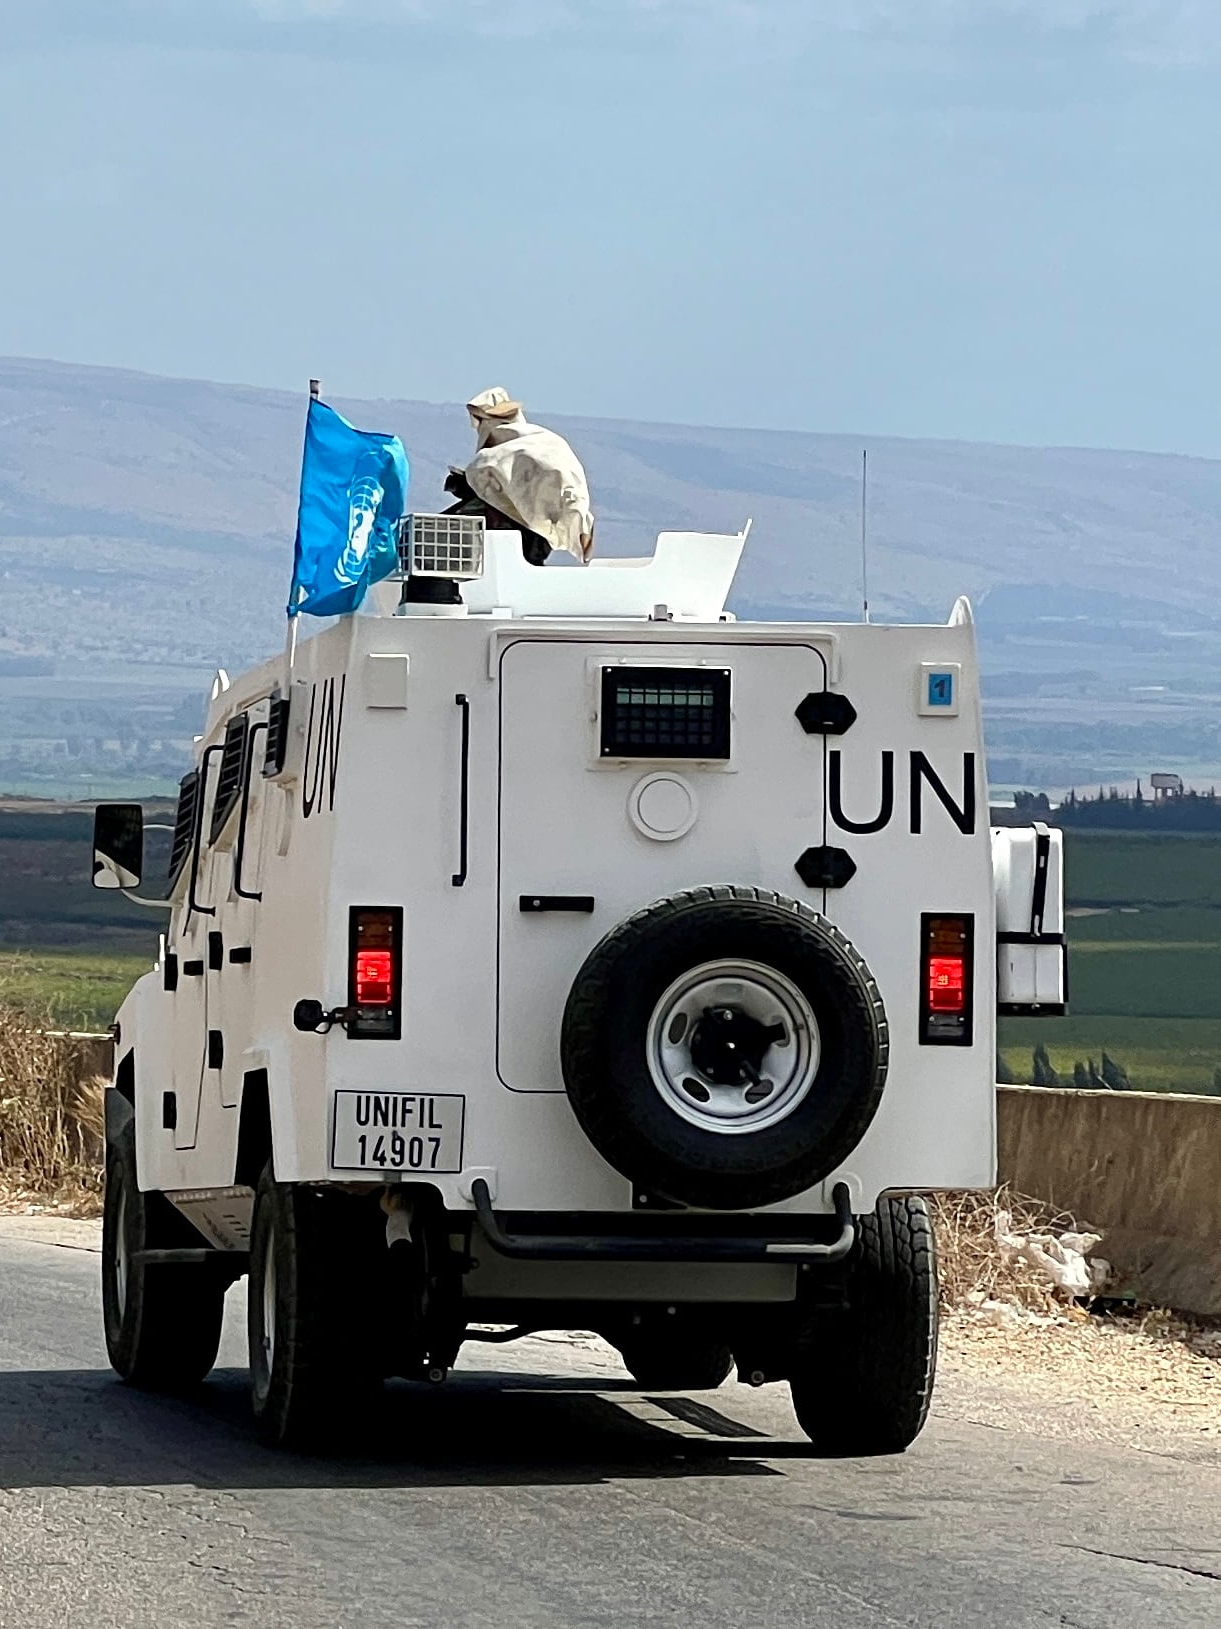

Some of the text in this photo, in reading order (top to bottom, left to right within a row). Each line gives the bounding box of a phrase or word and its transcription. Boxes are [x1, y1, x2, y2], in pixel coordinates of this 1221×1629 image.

[303, 673, 346, 818] UN
[829, 750, 975, 835] UN
[356, 1095, 442, 1129] UNIFIL
[358, 1134, 441, 1168] 14907
